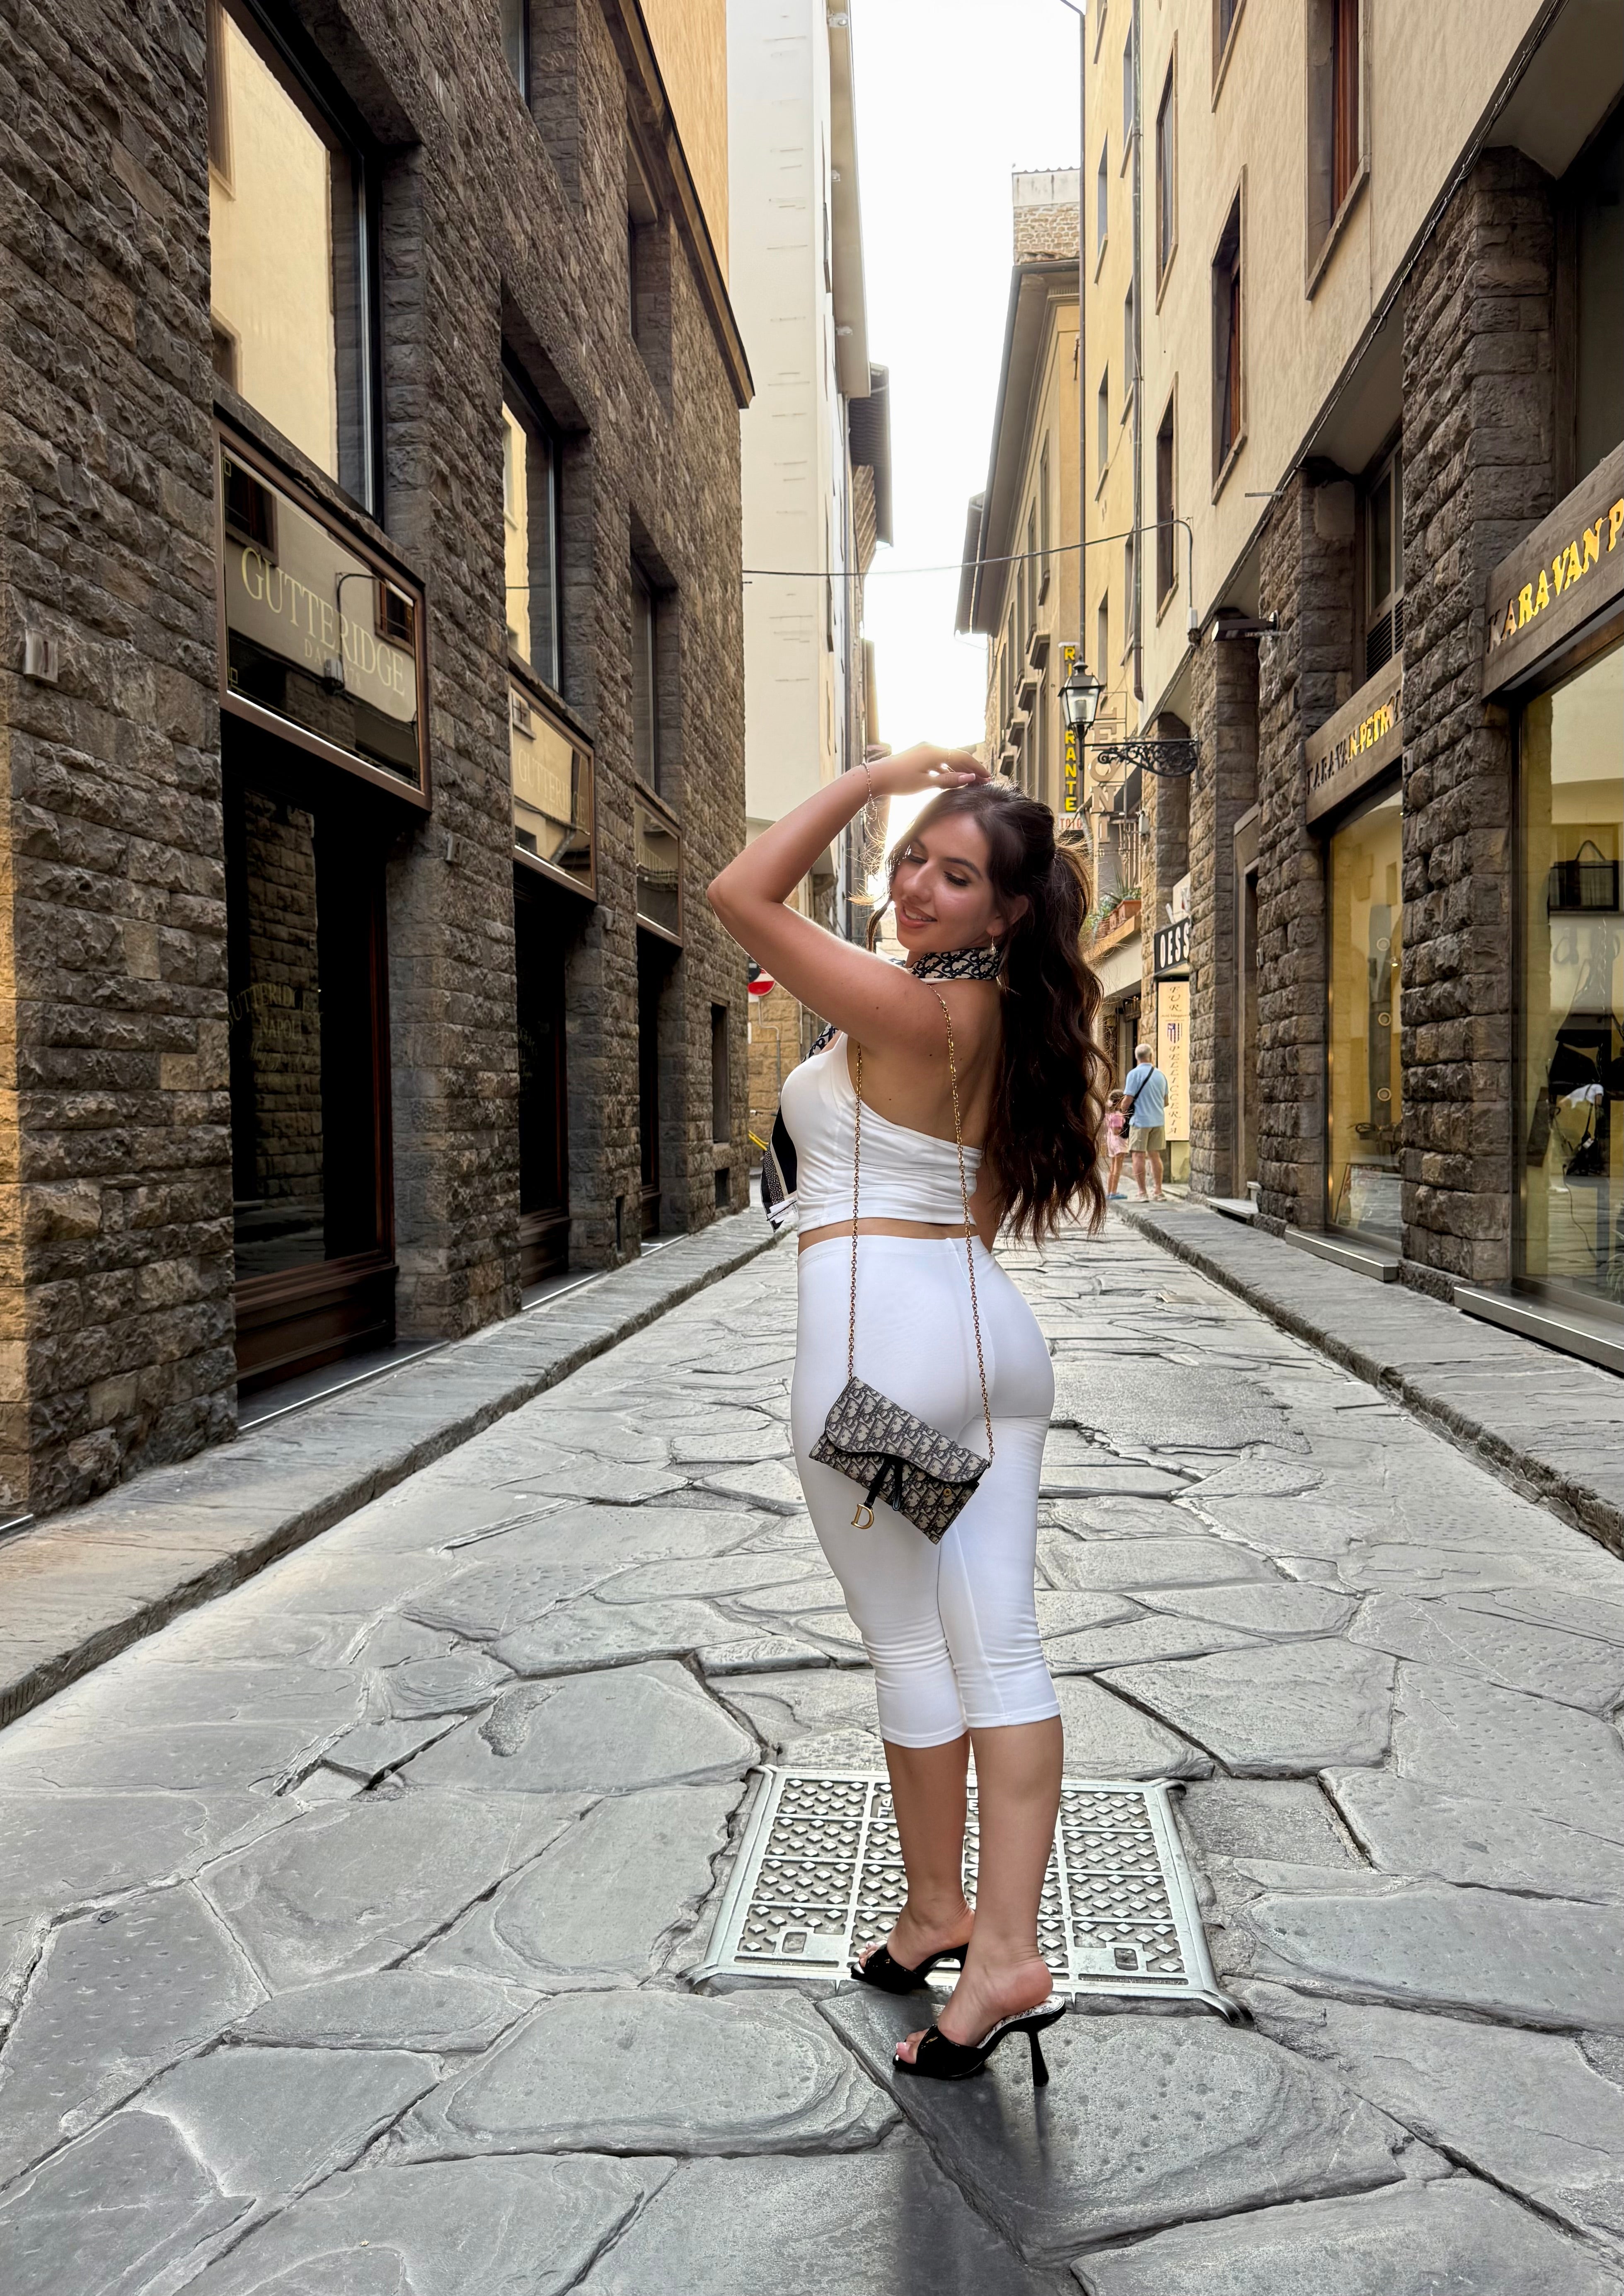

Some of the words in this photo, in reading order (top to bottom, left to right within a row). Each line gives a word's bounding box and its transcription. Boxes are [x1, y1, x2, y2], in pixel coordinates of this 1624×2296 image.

[241, 546, 405, 697] GUTTERIDGE
[1064, 646, 1077, 811] RIRANTE
[1169, 986, 1182, 1012] FUR
[1167, 1045, 1181, 1134] PELLICCERIA
